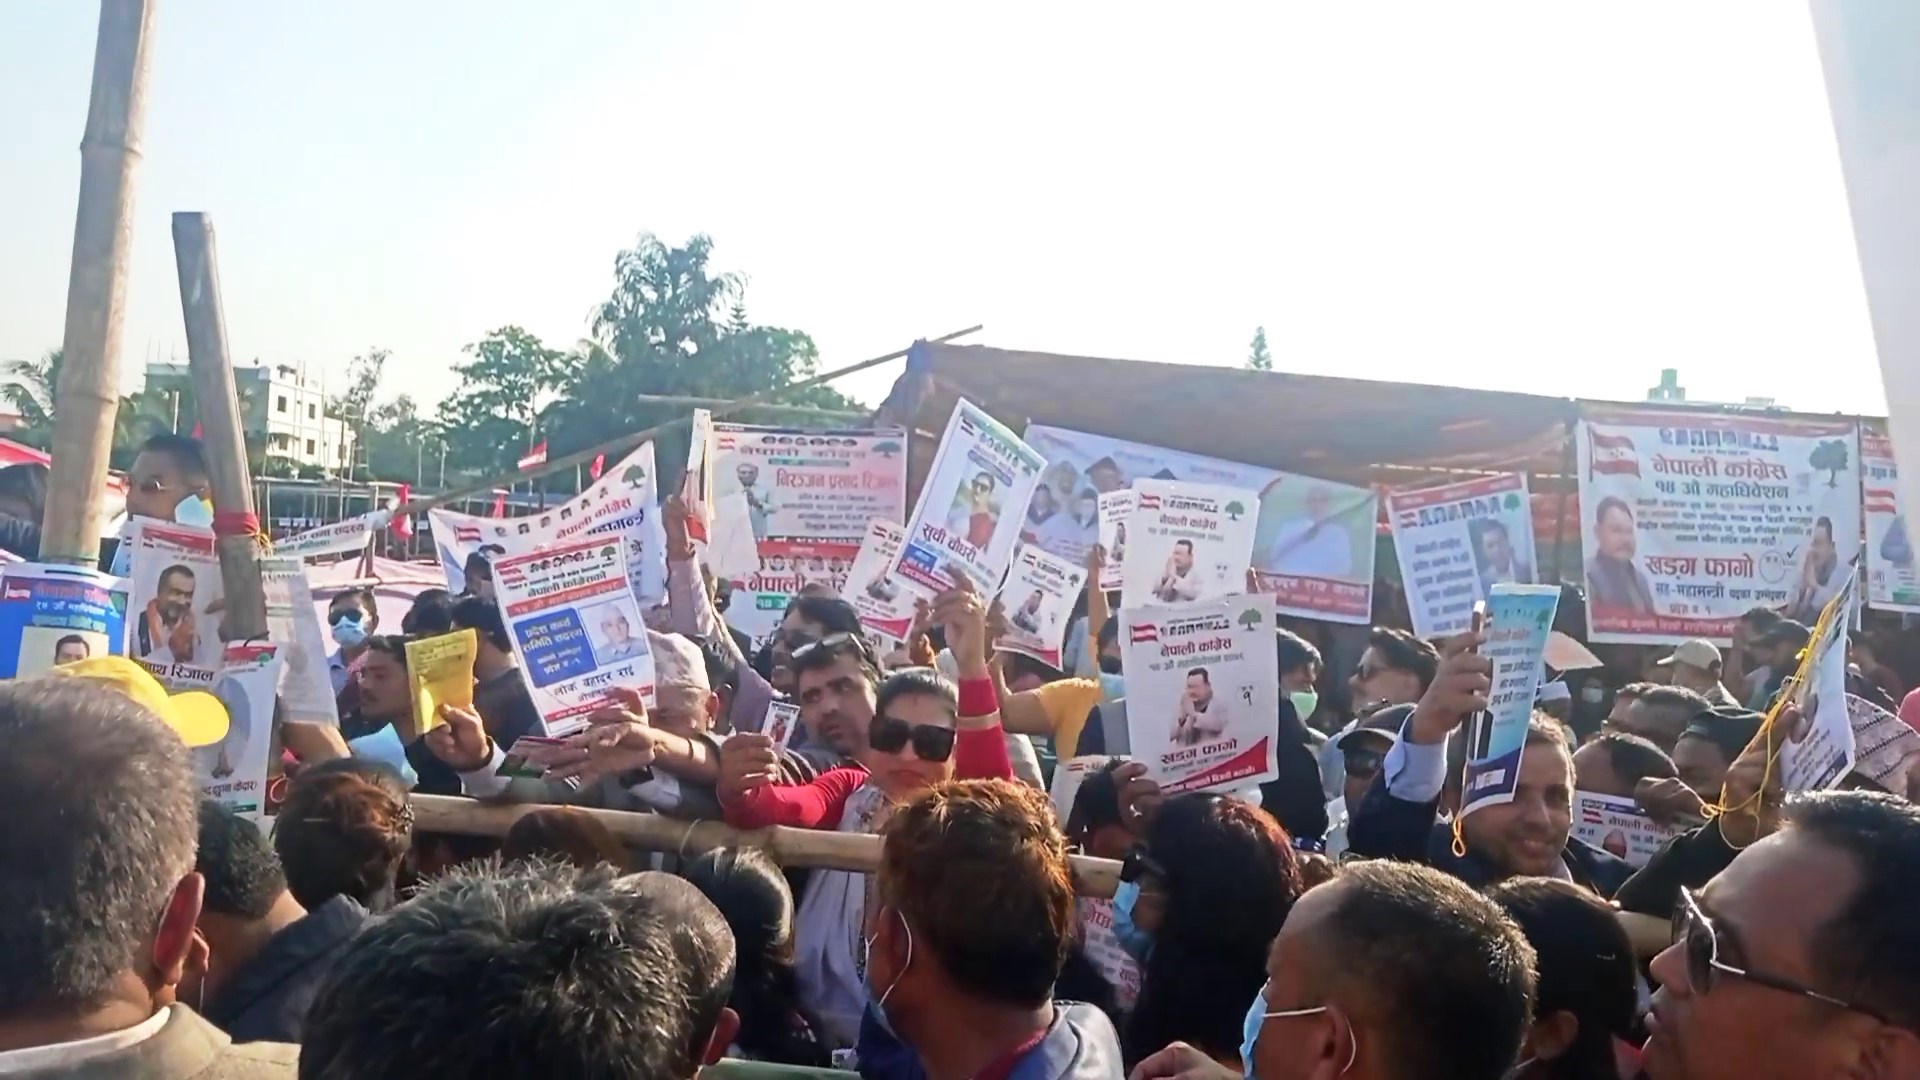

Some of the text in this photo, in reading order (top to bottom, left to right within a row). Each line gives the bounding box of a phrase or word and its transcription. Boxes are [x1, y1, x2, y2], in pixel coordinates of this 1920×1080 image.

[1653, 453, 1788, 480] नेपाली कांग्रेस
[1706, 480, 1789, 499] महाधिवेशन
[1704, 553, 1754, 578] फागो
[1160, 641, 1195, 658] नेपाली
[171, 661, 215, 682] रिजाल
[1202, 737, 1238, 755] फागो
